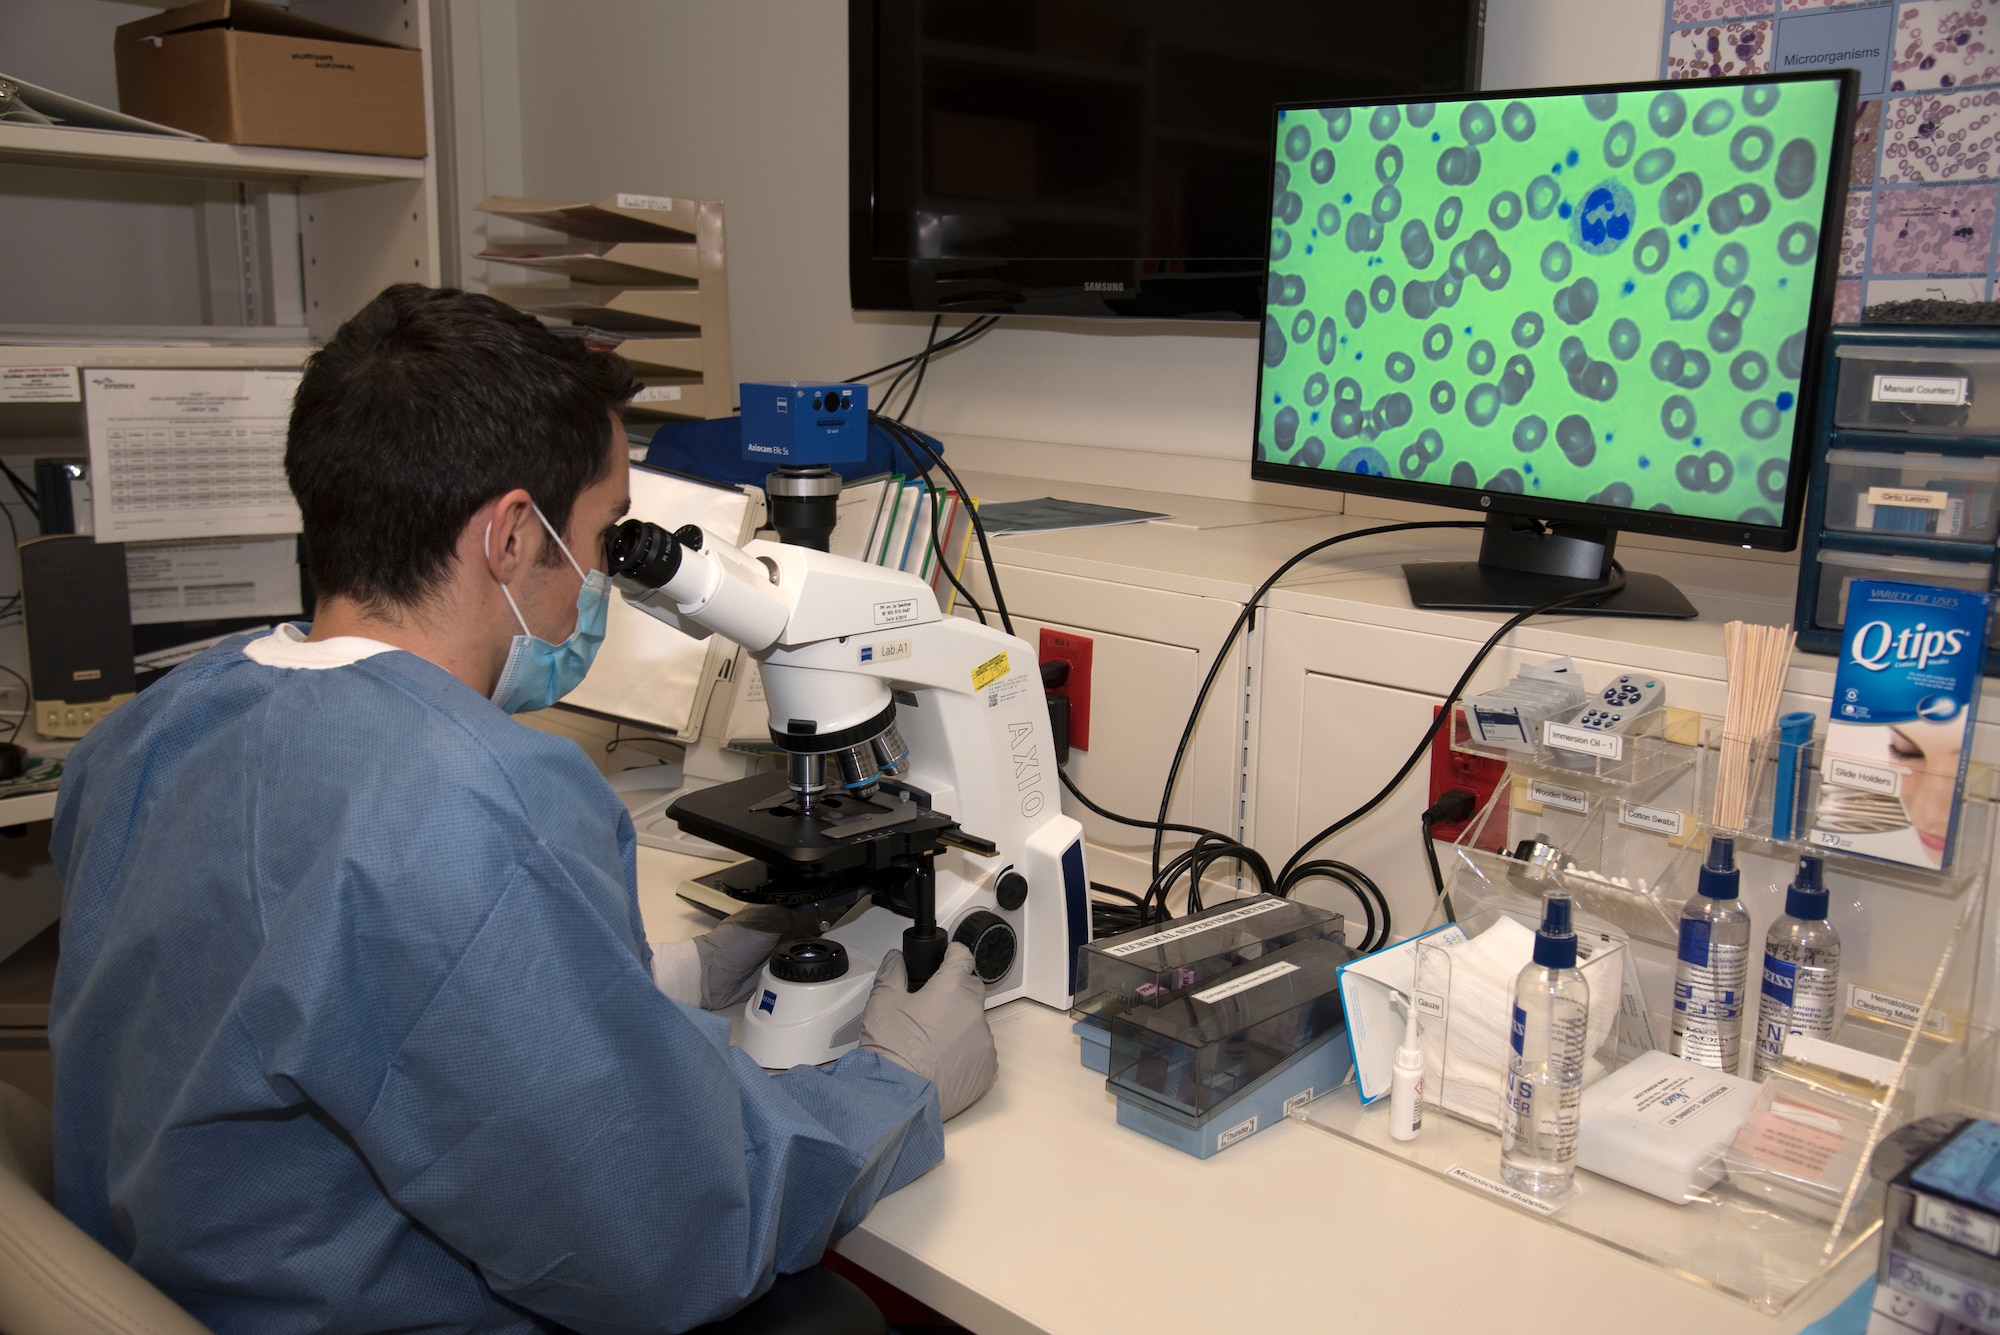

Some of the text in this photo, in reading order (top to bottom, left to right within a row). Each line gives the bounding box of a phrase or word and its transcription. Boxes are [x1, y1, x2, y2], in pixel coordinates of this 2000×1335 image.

[1784, 48, 1880, 66] Microorganisms
[1084, 282, 1124, 292] SAMSUNG
[1884, 385, 1956, 395] Manual Counters
[748, 443, 772, 454] Axiocam
[1871, 589, 1959, 607] VARIETY OF USES
[882, 642, 908, 656] Lab.A1
[1850, 620, 1966, 671] Q-tips
[1552, 730, 1588, 744] Immersion
[1589, 737, 1600, 747] Oil
[1008, 721, 1045, 818] AXIO
[1836, 768, 1891, 786] Slide Holders
[1535, 787, 1582, 804] Wooden Sticks
[1628, 810, 1676, 827] Cotton Swabs
[1113, 932, 1178, 953] TECHNICAL
[1179, 912, 1239, 936] SUPERVISOR
[1418, 997, 1440, 1011] Gauze
[1871, 993, 1920, 1014] Hematology
[1856, 999, 1938, 1028] Cleaning Materals
[1291, 1097, 1306, 1107] Friday
[1227, 1125, 1250, 1141] Thursday
[1455, 1169, 1510, 1195] Microscope
